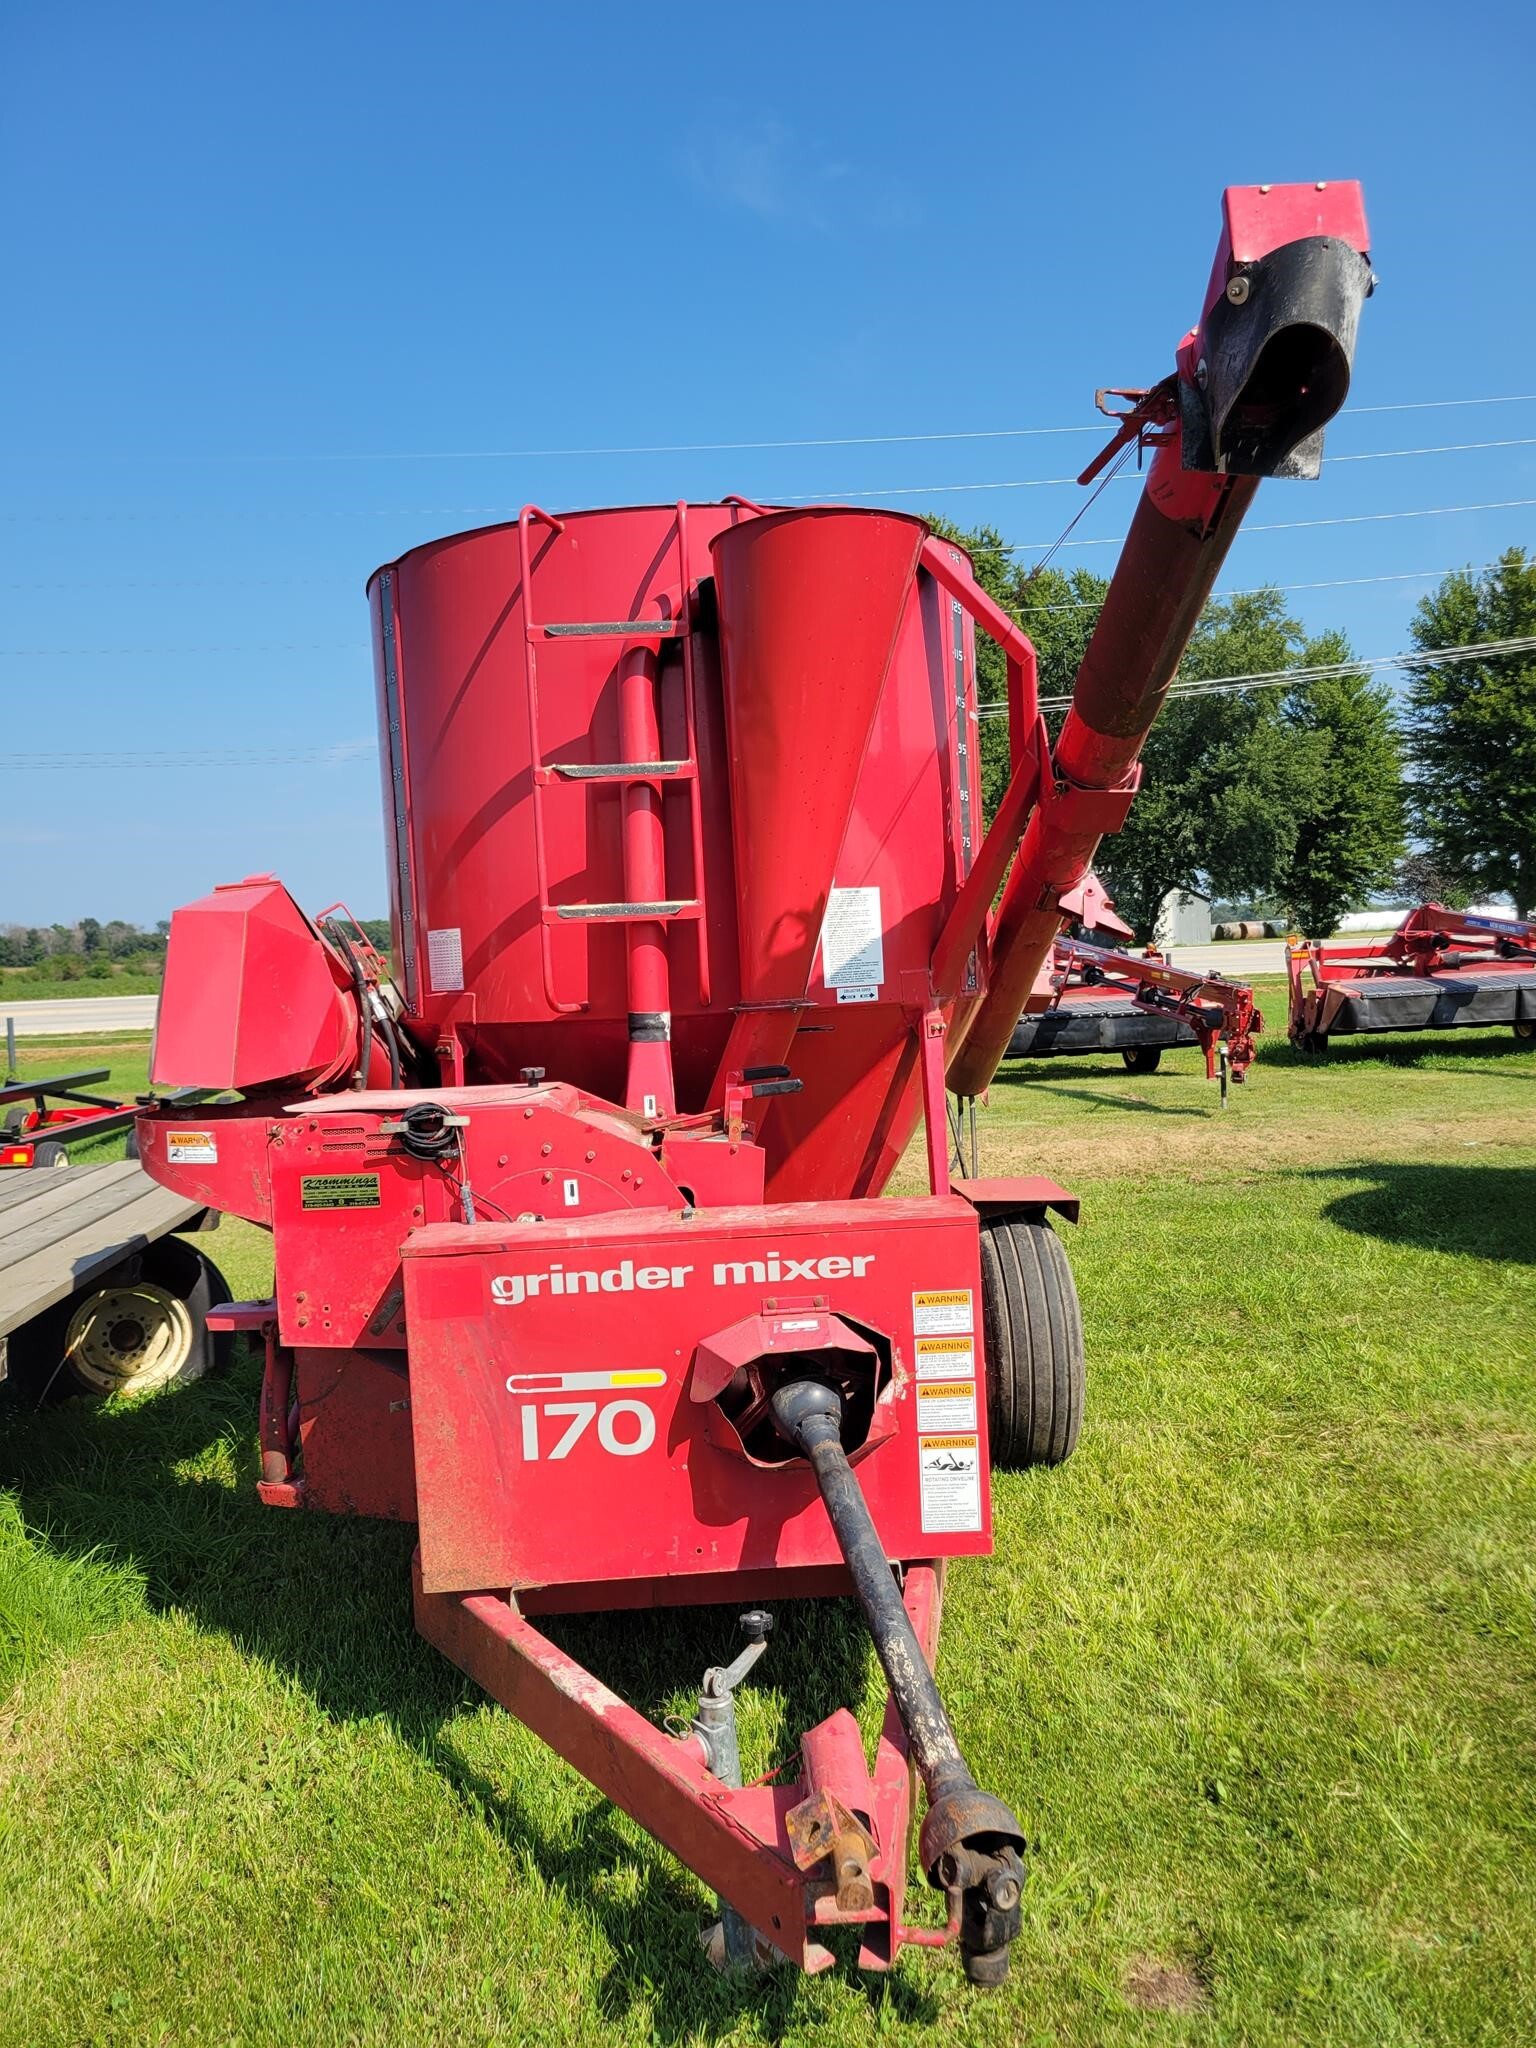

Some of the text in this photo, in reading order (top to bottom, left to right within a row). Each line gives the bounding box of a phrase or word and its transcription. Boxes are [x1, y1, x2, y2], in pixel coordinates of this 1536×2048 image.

[957, 742, 967, 755] 95
[392, 767, 403, 780] 95
[959, 789, 969, 802] 85
[962, 836, 971, 848] 75
[967, 975, 976, 986] 45
[303, 1176, 377, 1190] Kromminga
[491, 1252, 875, 1305] grinder mixer
[926, 1294, 968, 1304] WARNING
[927, 1341, 970, 1351] WARNING
[930, 1386, 971, 1396] WARNING
[521, 1400, 656, 1461] 170
[932, 1438, 975, 1447] WARNING
